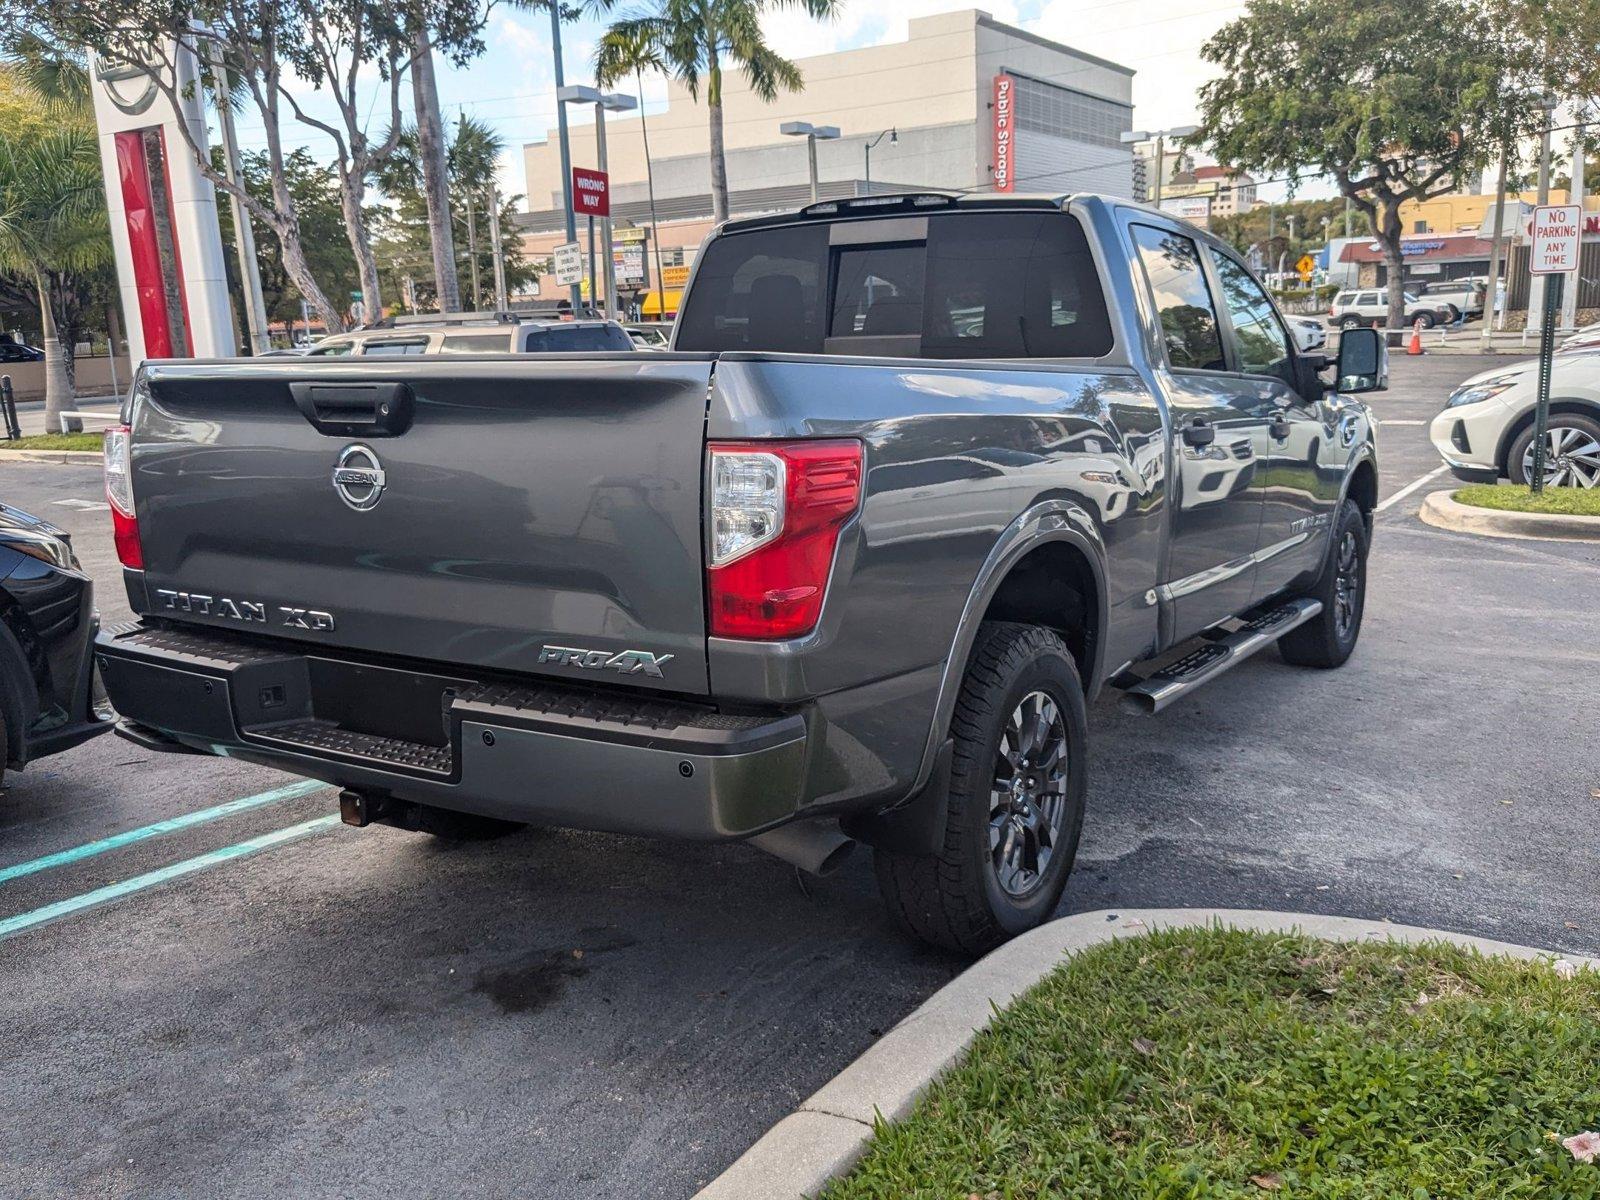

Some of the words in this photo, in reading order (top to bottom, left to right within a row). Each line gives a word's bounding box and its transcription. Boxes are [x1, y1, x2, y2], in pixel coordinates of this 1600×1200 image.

[998, 81, 1009, 128] Public
[995, 131, 1009, 188] Storage
[577, 177, 605, 192] WRONG
[582, 194, 600, 207] WAY
[1549, 211, 1566, 223] NO
[1537, 225, 1576, 238] PARKING
[1545, 242, 1566, 253] ANY
[1543, 254, 1567, 265] TIME
[337, 472, 378, 485] NISSAN
[156, 588, 267, 623] TITAN
[276, 606, 336, 632] XD
